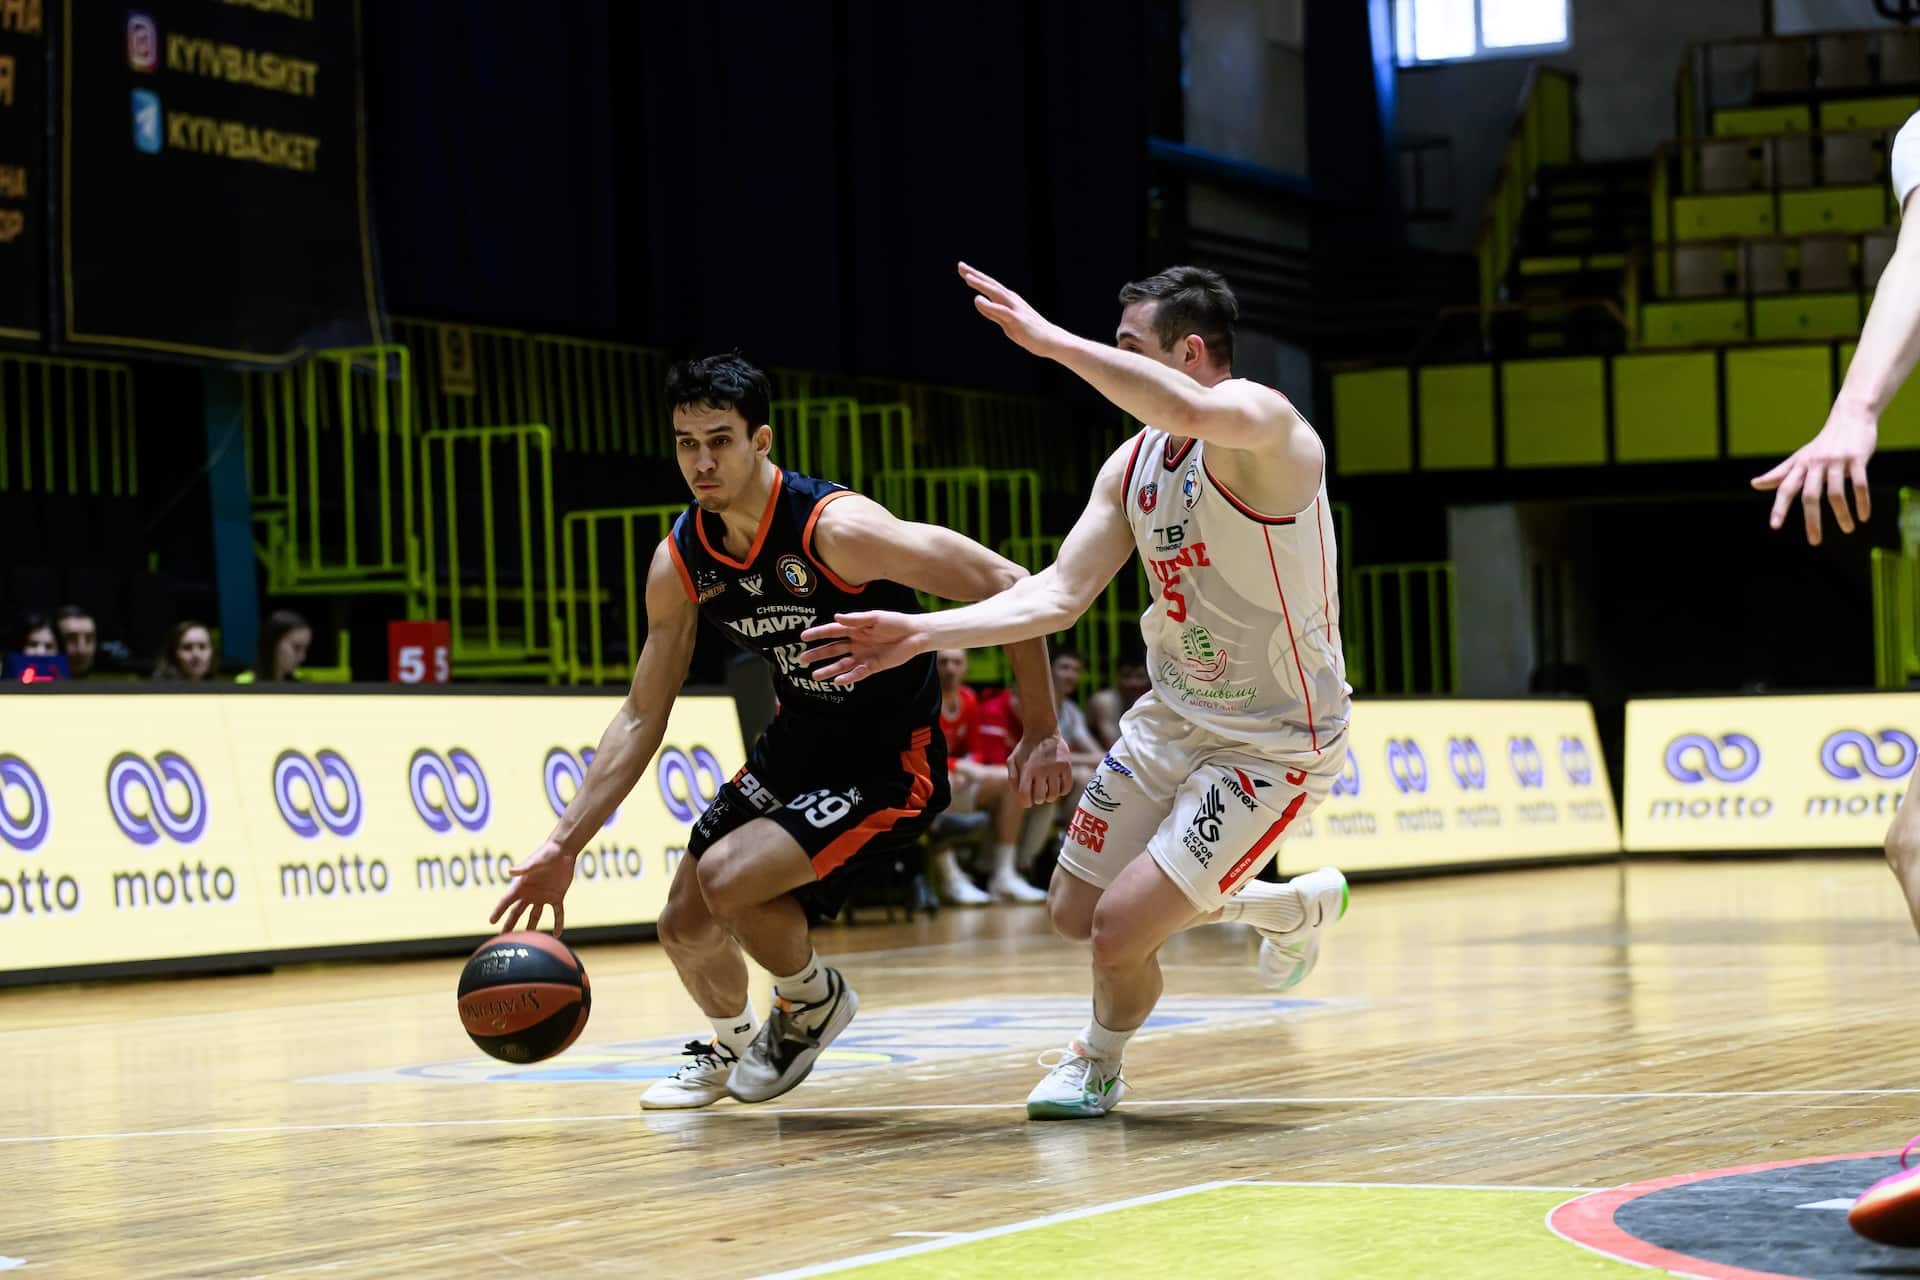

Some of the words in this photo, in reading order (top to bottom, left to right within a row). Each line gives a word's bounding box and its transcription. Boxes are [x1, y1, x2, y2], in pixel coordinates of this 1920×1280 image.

[166, 33, 319, 97] KYIVBASKET
[167, 111, 320, 172] KYIVBASKET
[756, 605, 816, 615] CHERKASKI
[1163, 574, 1187, 623] 5
[399, 646, 425, 683] 5
[1649, 796, 1774, 817] motto
[1806, 793, 1904, 816] mott
[577, 843, 641, 880] otto
[1183, 836, 1209, 870] GLOBAL
[1186, 827, 1213, 860] VECTOR
[113, 861, 235, 907] motto
[281, 854, 388, 897] motto
[417, 848, 514, 888] motto
[0, 869, 79, 914] otto
